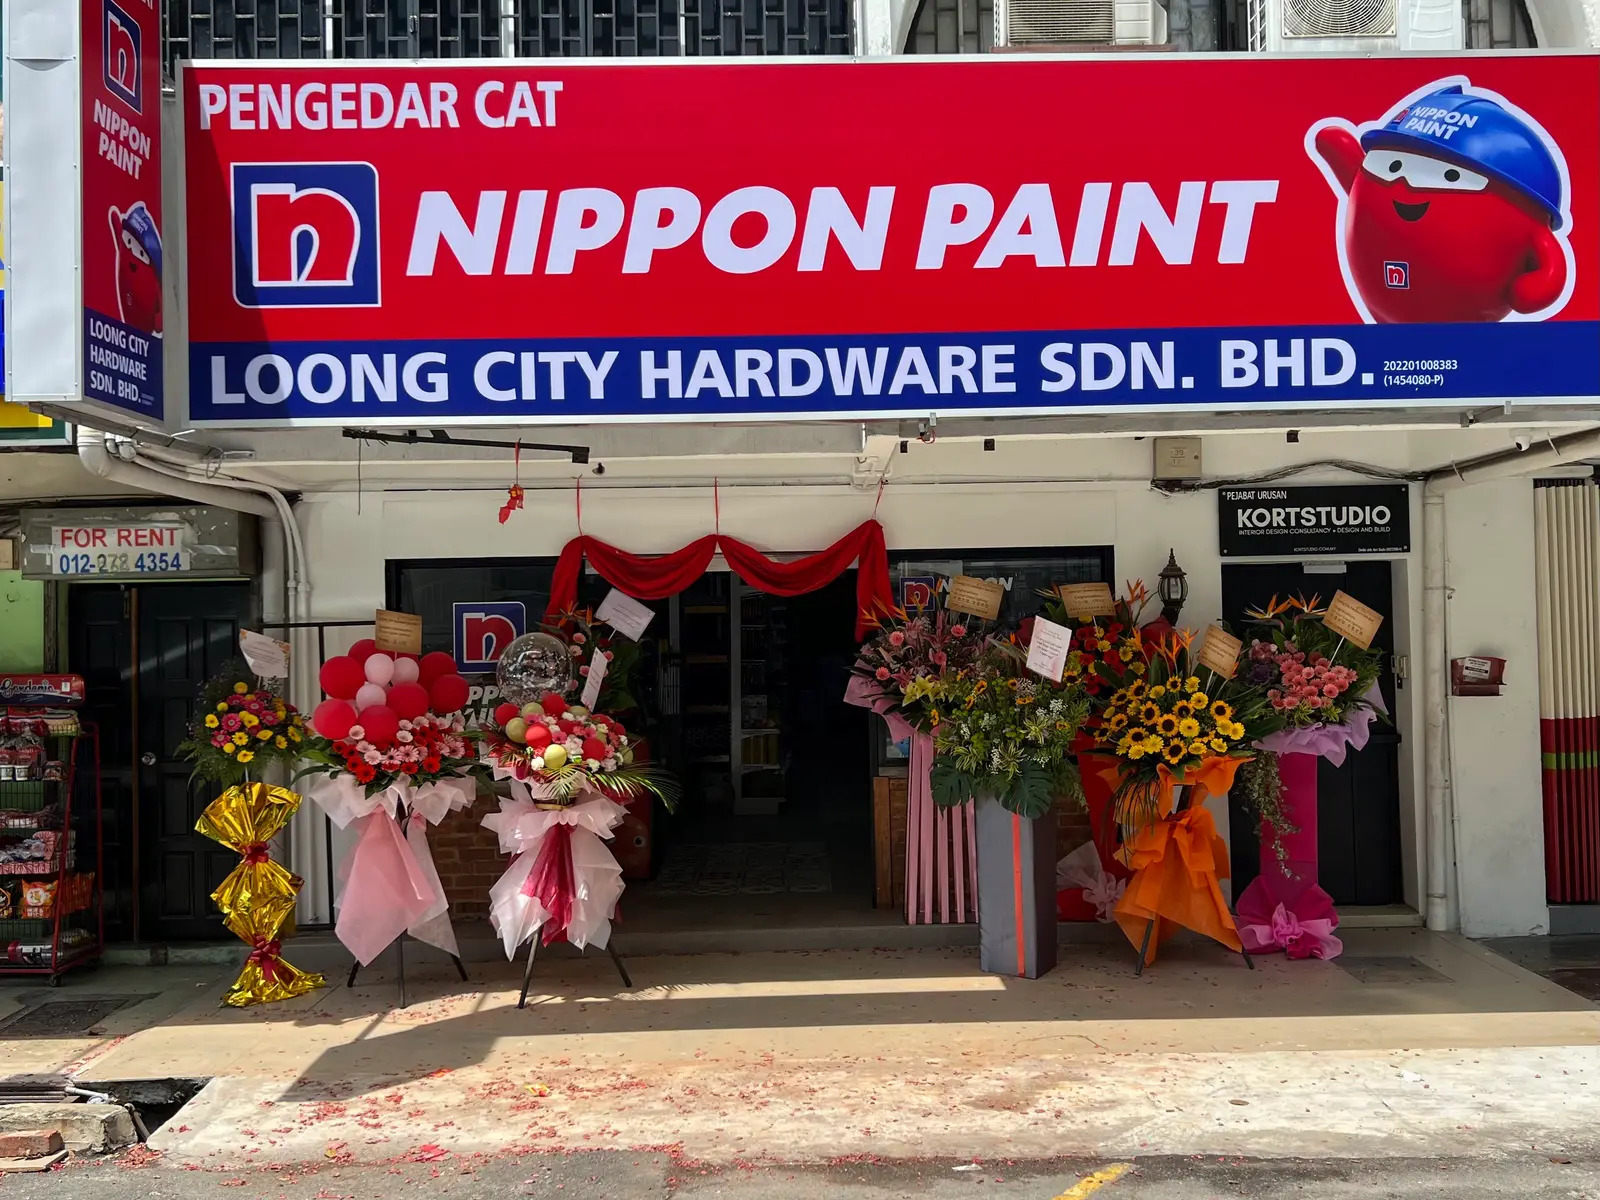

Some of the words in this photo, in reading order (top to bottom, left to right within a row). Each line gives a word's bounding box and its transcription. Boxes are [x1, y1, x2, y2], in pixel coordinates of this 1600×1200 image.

[200, 82, 460, 130] PENGEDAR
[475, 81, 564, 128] CAT
[1410, 106, 1479, 128] NIPPON
[94, 99, 151, 160] NIPPON
[1405, 117, 1459, 140] PAINT
[98, 132, 142, 179] PAINT
[406, 186, 896, 276] NIPPON
[916, 180, 1279, 269] PAINT
[90, 318, 126, 349] LOONG
[129, 335, 149, 357] CITY
[90, 344, 147, 381] HARDWARE
[211, 352, 448, 404] LOONG
[474, 351, 619, 401] CITY
[641, 345, 1017, 398] HARDWARE
[1041, 342, 1195, 393] SDN.
[1221, 338, 1375, 390] BHD.
[1383, 360, 1458, 371] 202201008383
[90, 370, 115, 395] SDN.
[118, 379, 141, 402] BHD.
[1383, 374, 1444, 387] (1454080-P)
[1226, 490, 1255, 501] PEJABAT
[1257, 490, 1287, 500] URUSAN
[1237, 505, 1391, 528] KORTSTUDIO
[61, 529, 107, 548] FOR
[117, 528, 178, 547] RENT
[1289, 527, 1332, 535] CONSULTANCY
[135, 552, 181, 573] 4354
